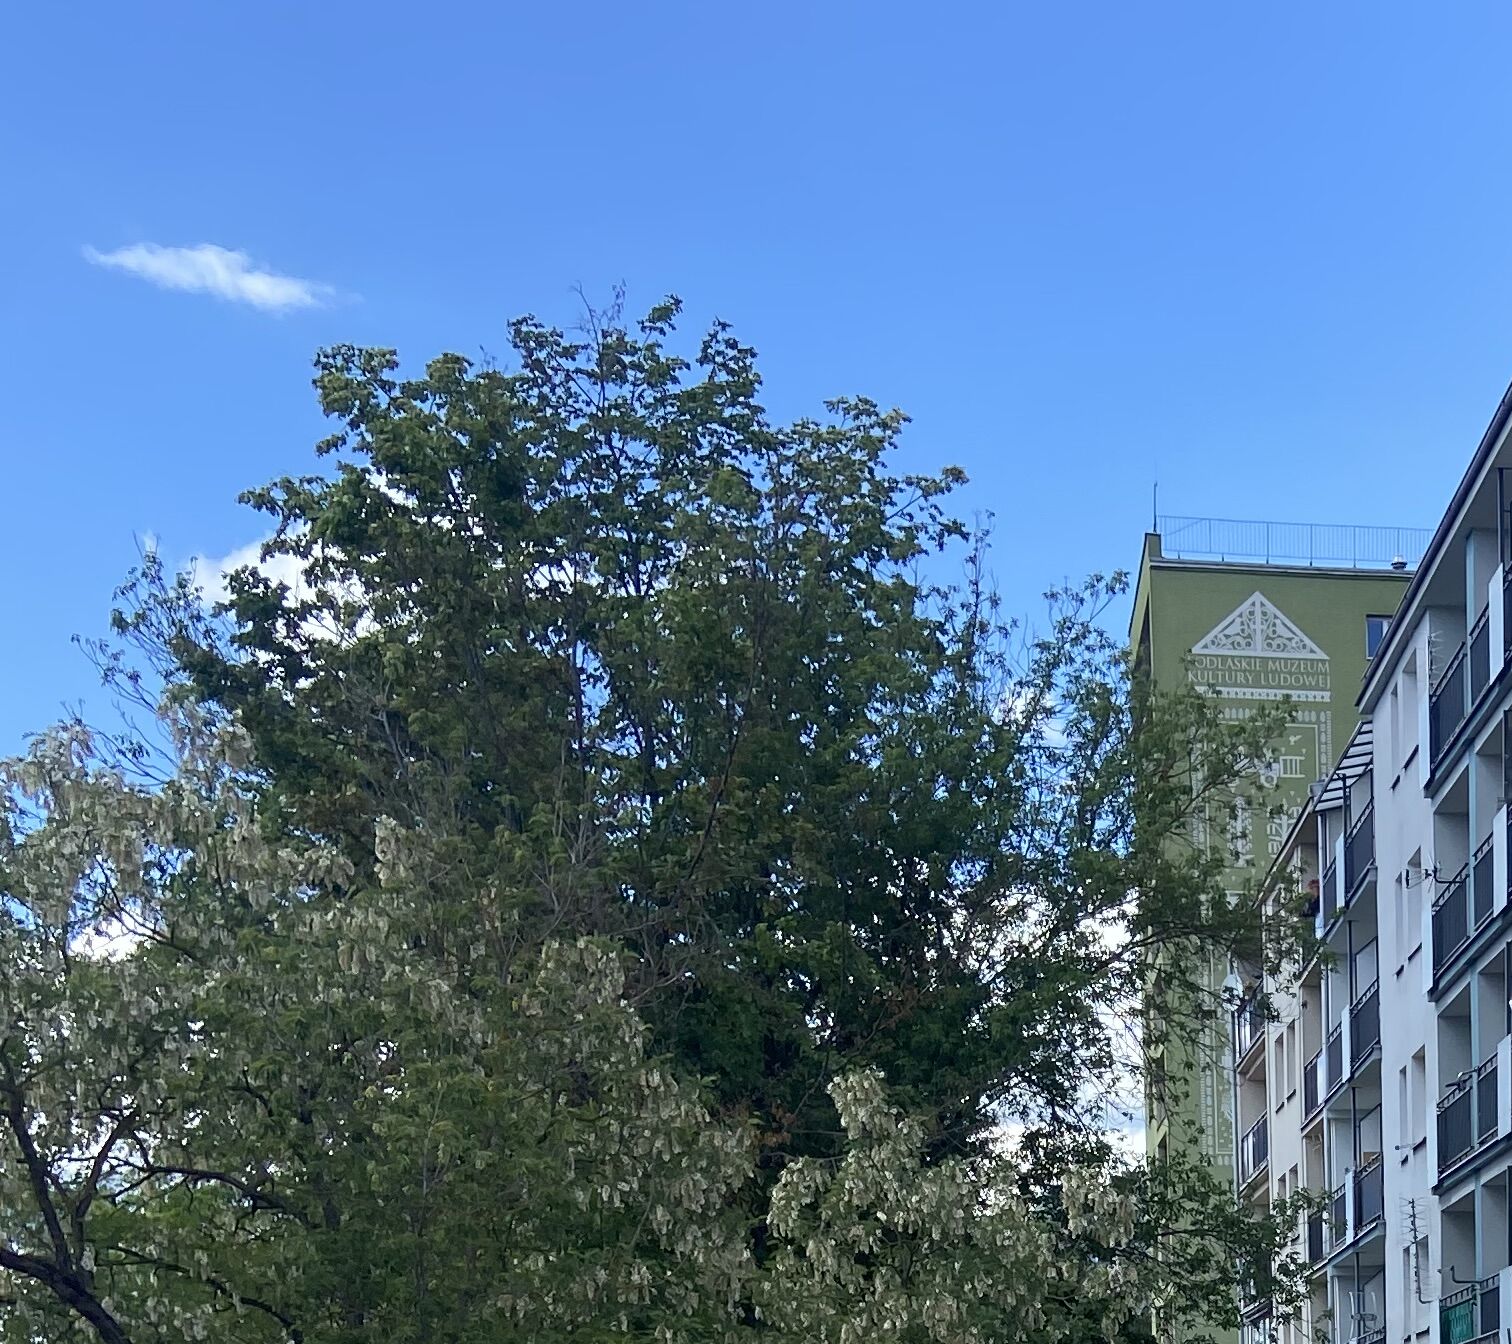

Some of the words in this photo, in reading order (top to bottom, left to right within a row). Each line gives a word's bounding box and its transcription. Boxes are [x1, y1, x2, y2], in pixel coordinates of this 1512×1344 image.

[1267, 659, 1331, 673] MUZEUM
[1187, 670, 1256, 684] KULTURY
[1260, 672, 1331, 689] LUDOWEJ
